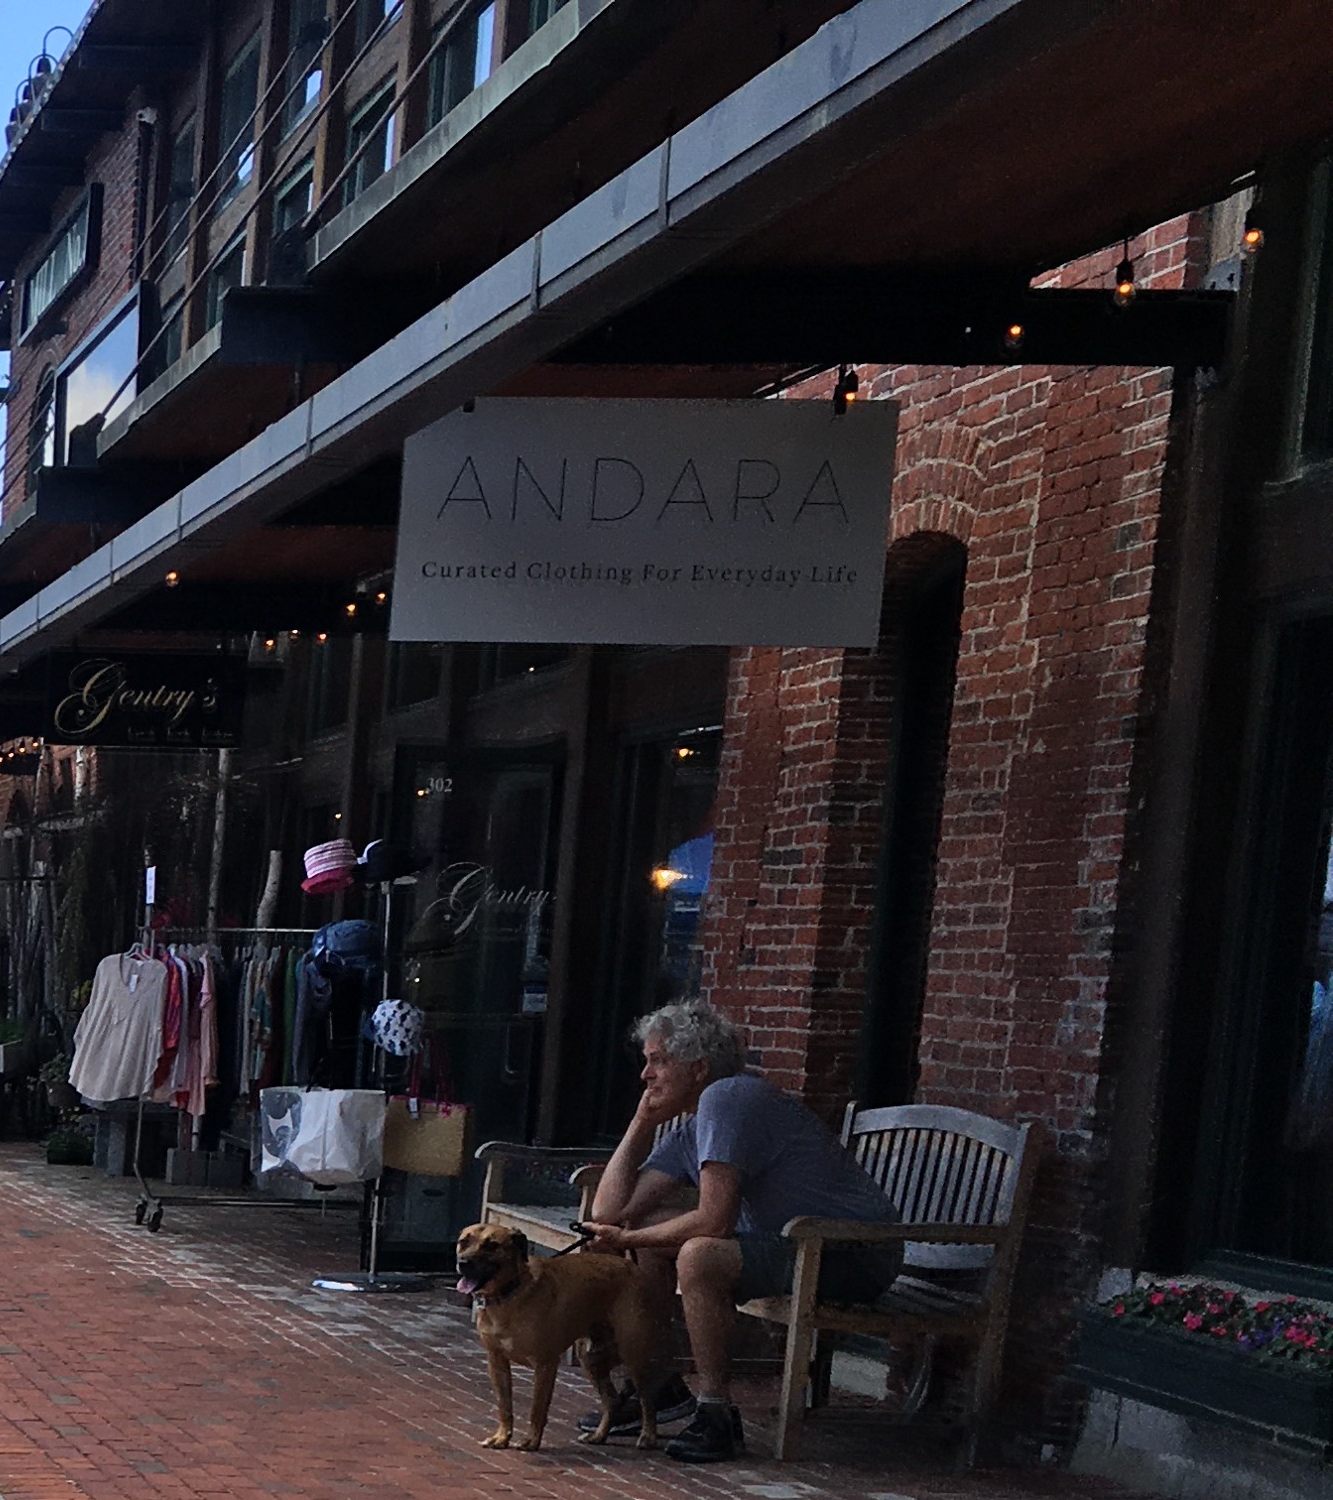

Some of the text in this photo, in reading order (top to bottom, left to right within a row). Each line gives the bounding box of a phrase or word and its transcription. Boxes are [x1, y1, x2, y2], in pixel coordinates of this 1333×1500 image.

[436, 455, 850, 524] ANDARA
[421, 560, 858, 587] Curated Clothing For Everyday Life
[427, 777, 453, 793] 302
